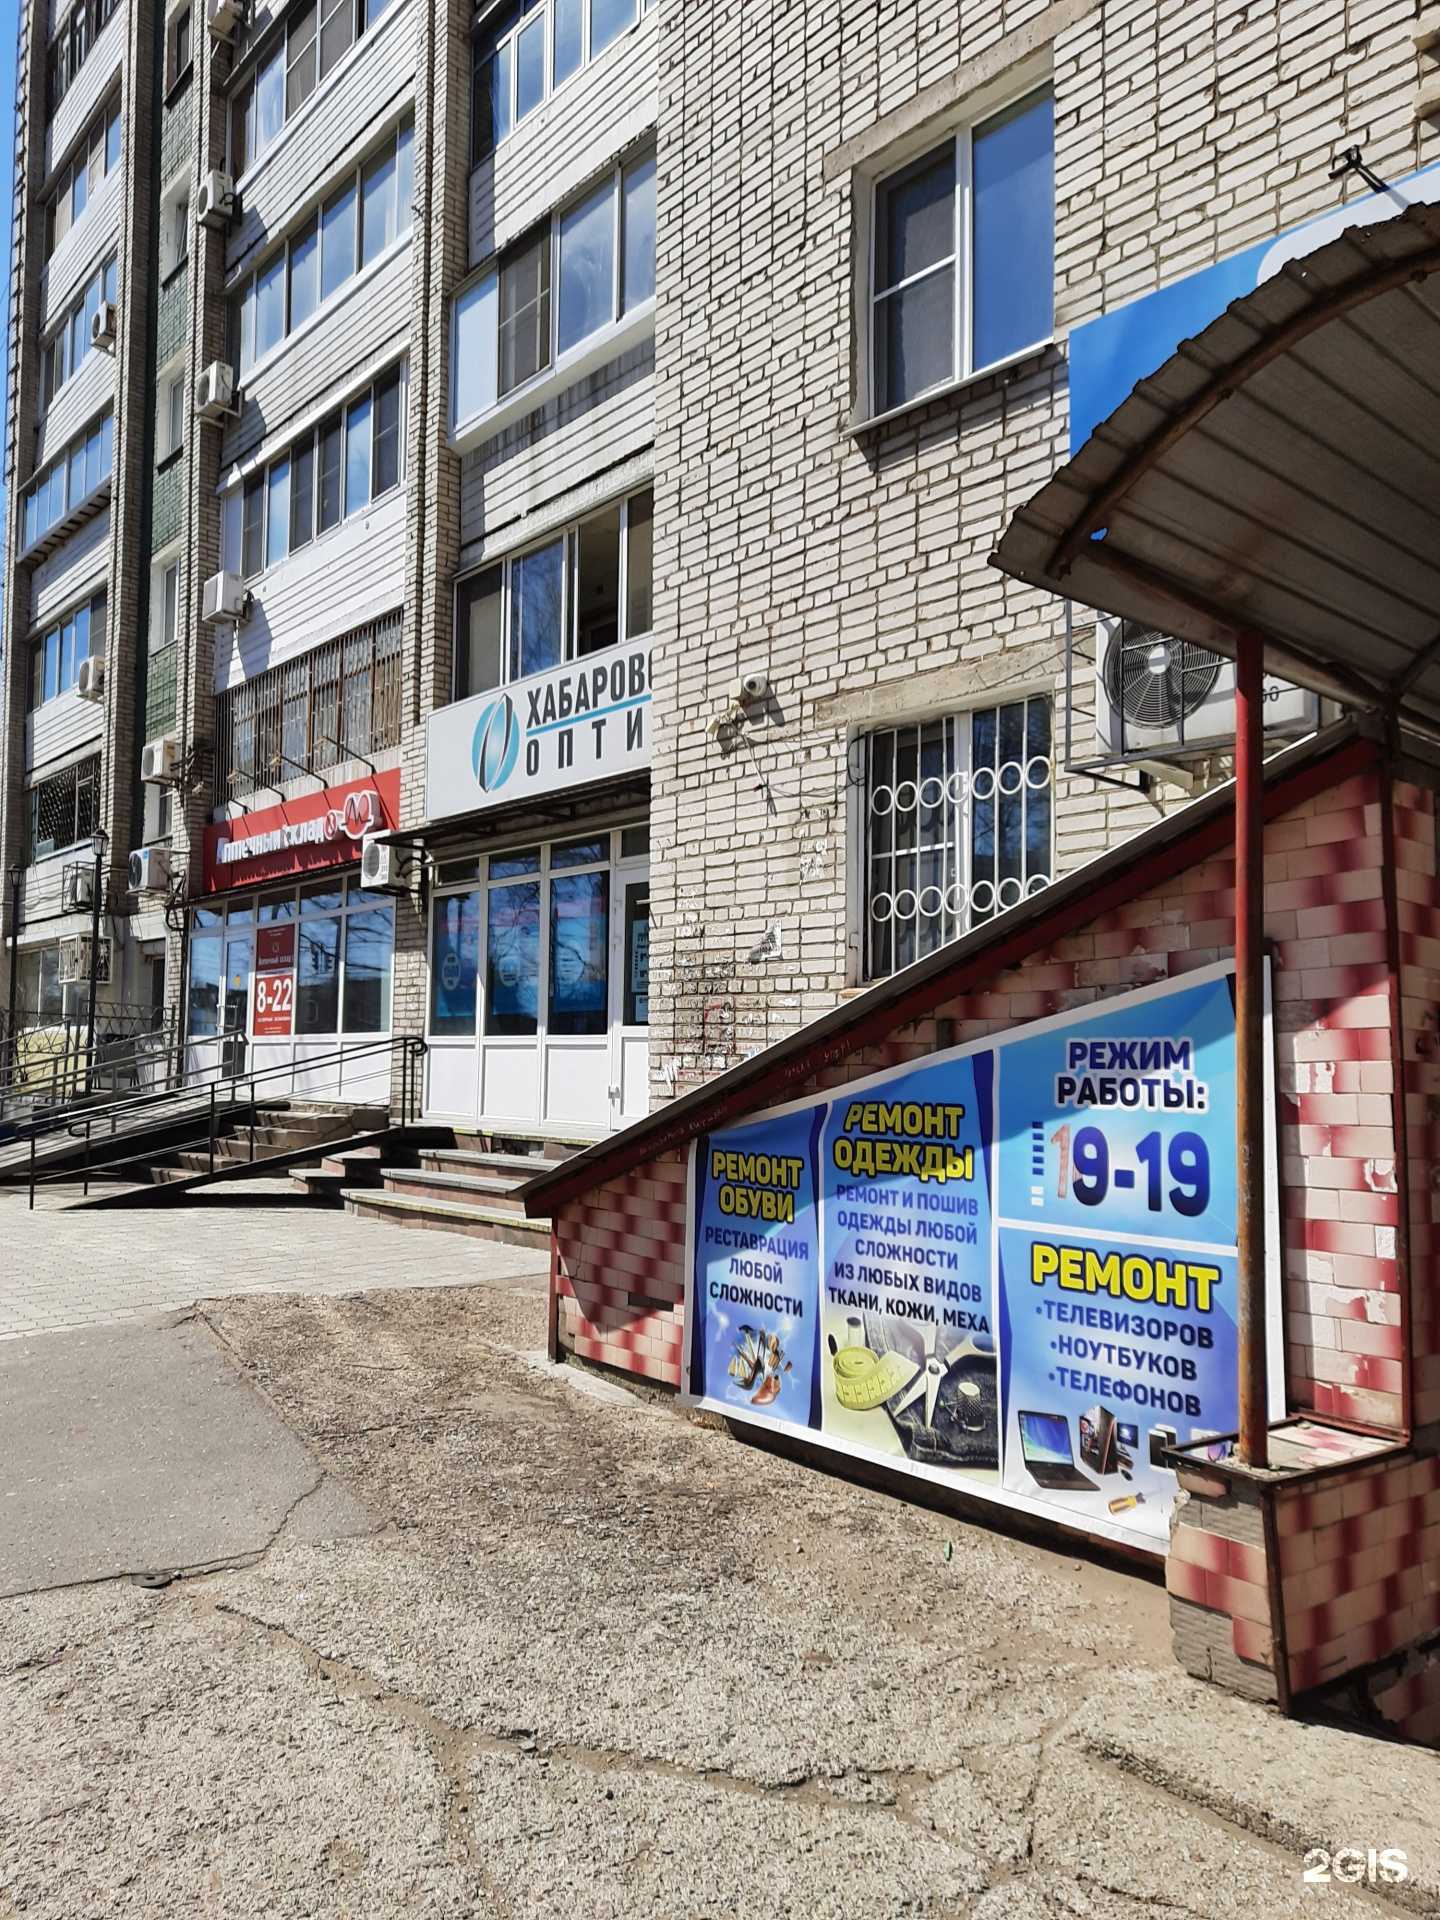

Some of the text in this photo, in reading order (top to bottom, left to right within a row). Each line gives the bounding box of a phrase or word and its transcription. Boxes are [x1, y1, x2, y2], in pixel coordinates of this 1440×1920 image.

[527, 650, 652, 729] ХАБАРОВ
[257, 977, 292, 1013] 8-22
[1068, 1040, 1191, 1071] РЕЖИМ
[1057, 1076, 1206, 1109] РАБОТЫ:
[843, 1103, 964, 1138] РЕМОНТ
[712, 1150, 803, 1189] РЕМОНТ
[834, 1138, 974, 1184] ОДЕЖДЫ
[719, 1184, 794, 1223] ОБУВИ
[836, 1184, 979, 1217] РЕМОНТ И ПОШИВ
[705, 1226, 809, 1261] РЕСТАВРАЦИЯ
[837, 1210, 977, 1245] ОДЕЖДЫ ЛЮБОЙ
[729, 1257, 783, 1284] ЛЮБОЙ
[855, 1238, 958, 1270] СЛОЖНОСТИ
[834, 1261, 982, 1304] ИЗ ЛЮБЫХ ВИДОВ
[1032, 1243, 1220, 1312] РЕМОНТ
[709, 1281, 803, 1318] СЛОЖНОСТИ
[828, 1287, 990, 1335] ТКАНИ, КОЖИ, МЕХА
[1043, 1300, 1214, 1349] ТЕЛЕВИЗОРОВ
[1058, 1334, 1197, 1381] НОУТБУКОВ
[1056, 1366, 1202, 1417] ТЕЛЕФОНОВ
